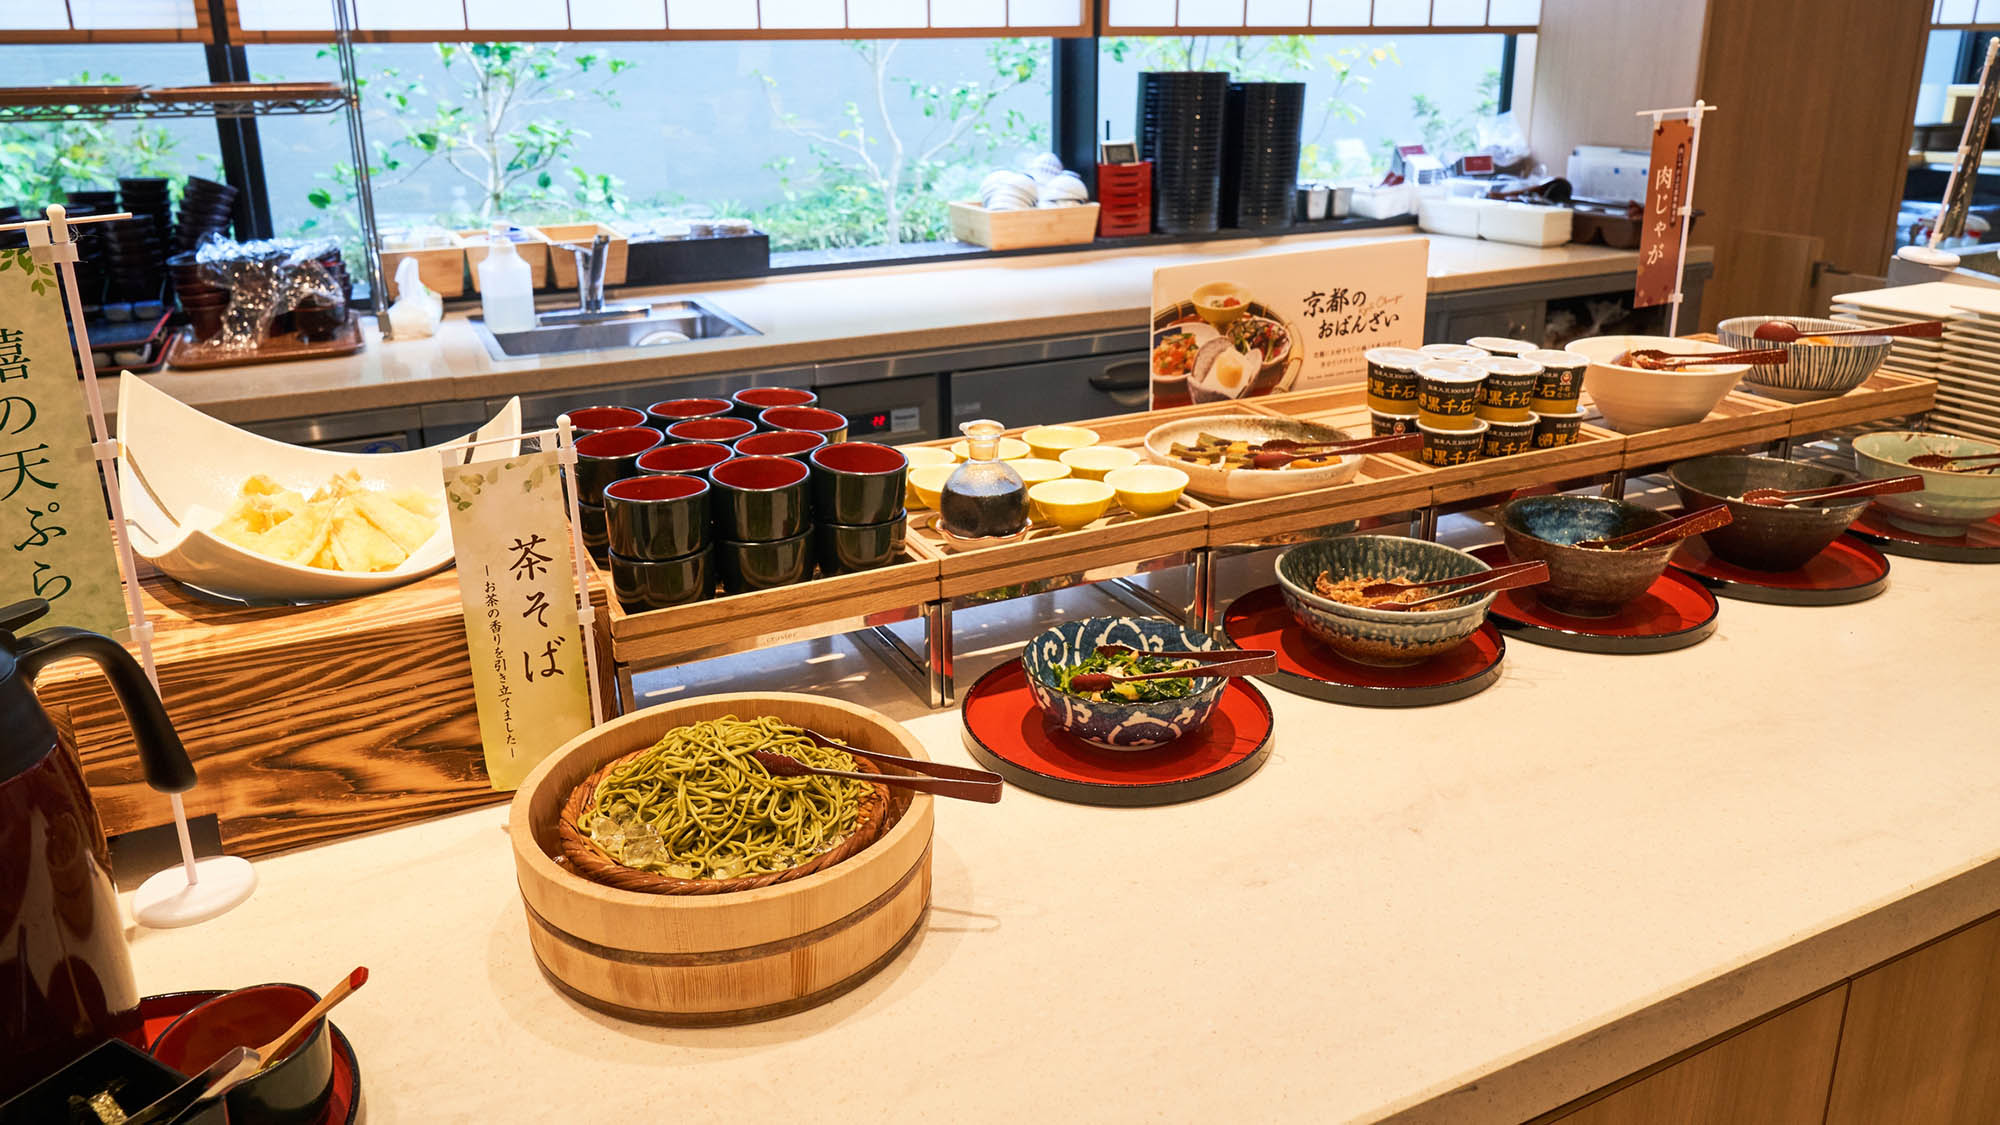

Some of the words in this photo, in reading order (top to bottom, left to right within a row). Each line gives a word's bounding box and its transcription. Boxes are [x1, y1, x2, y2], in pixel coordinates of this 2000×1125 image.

[1647, 165, 1673, 265] 肉じゃが
[1303, 288, 1367, 317] 京都の
[1318, 311, 1400, 339] おばんざい
[508, 534, 566, 683] 茶そば
